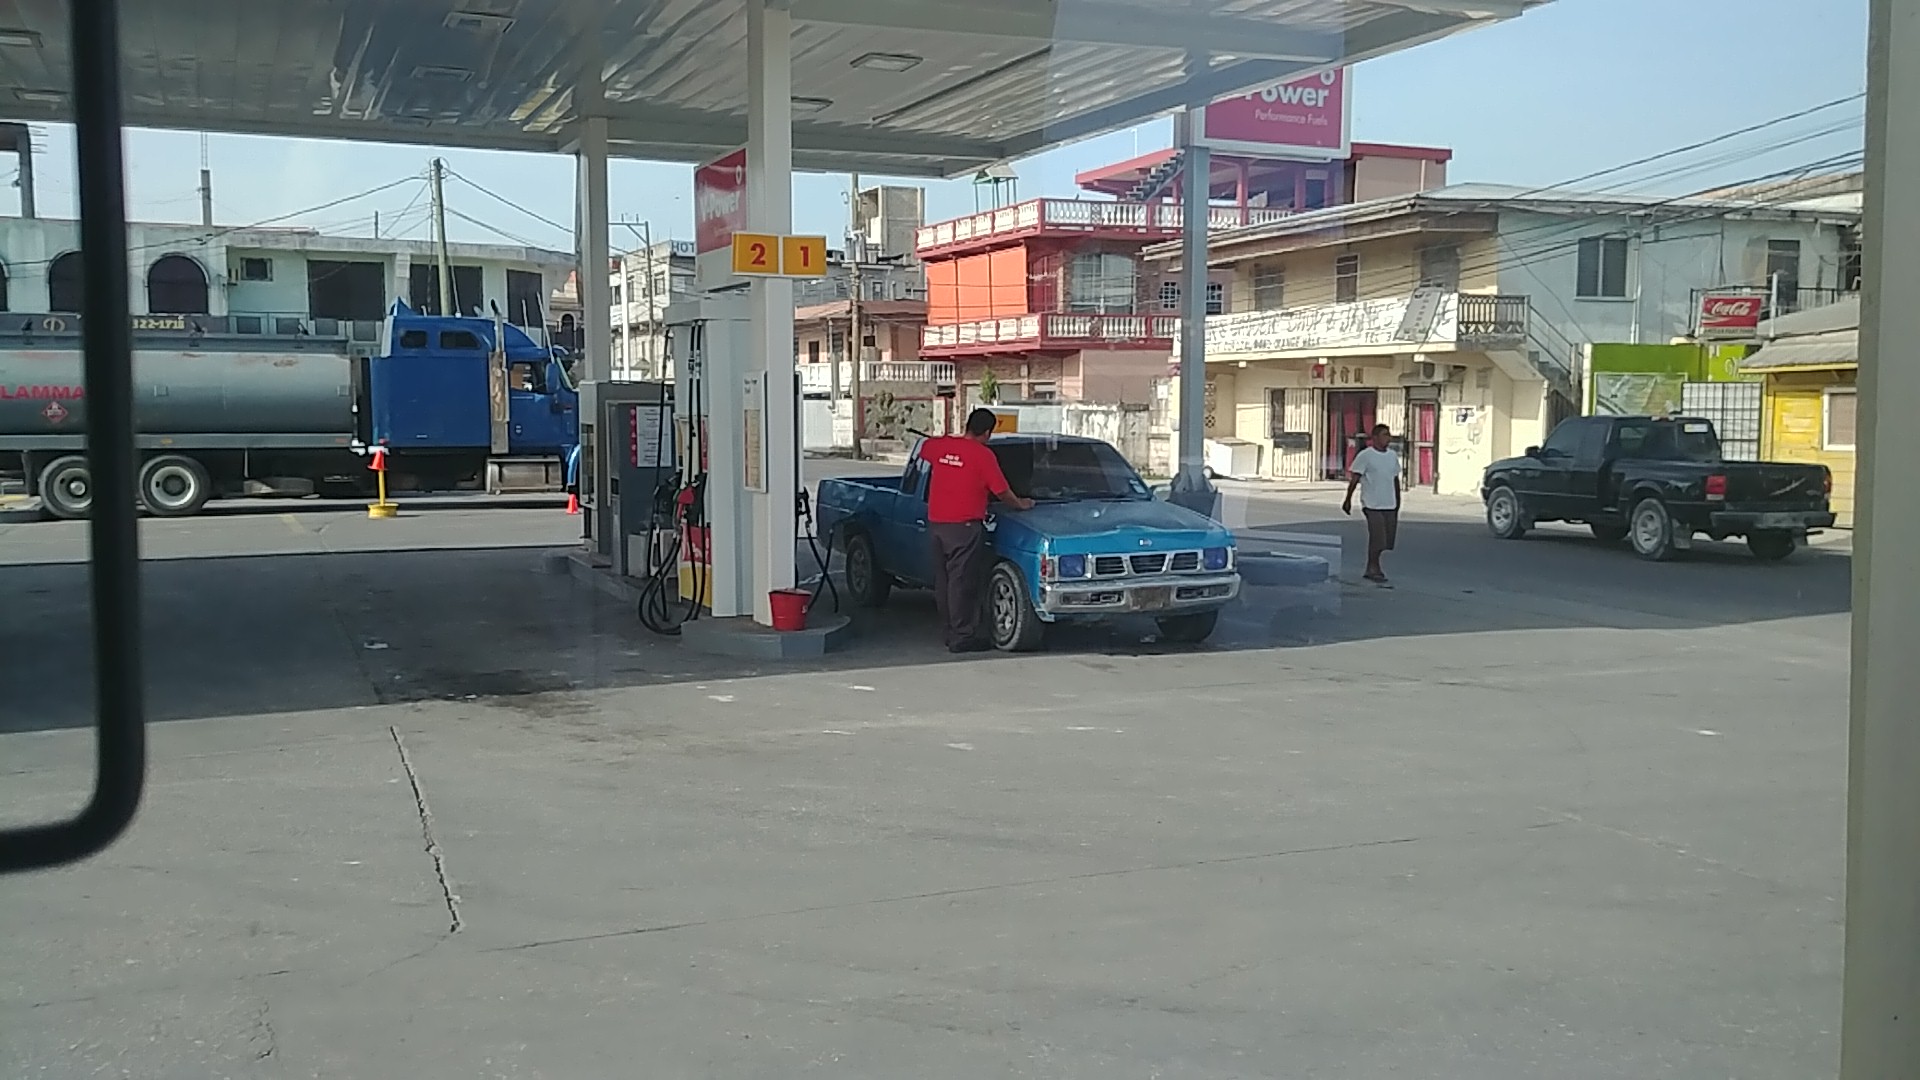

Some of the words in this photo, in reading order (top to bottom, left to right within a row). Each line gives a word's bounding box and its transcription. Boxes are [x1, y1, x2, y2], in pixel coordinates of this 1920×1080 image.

[1245, 84, 1329, 108] ower
[1254, 108, 1306, 125] Performance
[1307, 113, 1328, 126] Fuels
[750, 243, 766, 266] 2
[800, 245, 809, 267] 1
[1711, 301, 1752, 316] Coca-Cola
